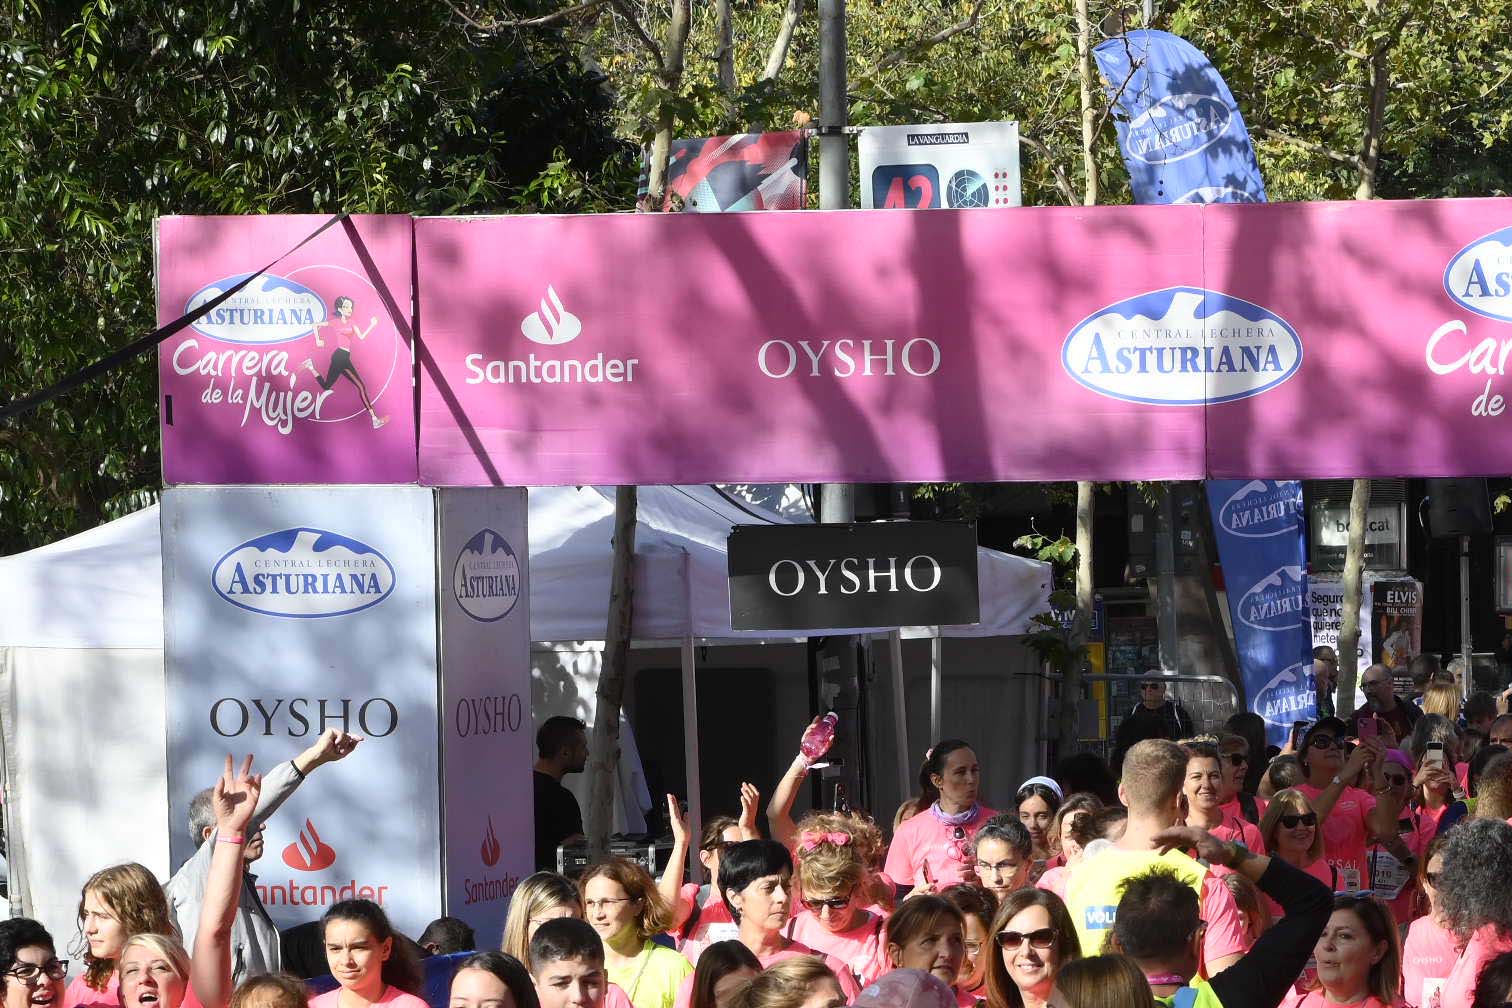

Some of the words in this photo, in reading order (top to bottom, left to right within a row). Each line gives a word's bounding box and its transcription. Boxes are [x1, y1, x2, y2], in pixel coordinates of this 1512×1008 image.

[920, 132, 968, 144] VANGUARDIA
[196, 299, 315, 325] ASTURIANA
[1117, 326, 1192, 339] CENTRAL
[1204, 325, 1276, 338] LECHERA
[172, 339, 289, 377] Carrera
[465, 353, 639, 384] Santander
[758, 337, 941, 379] OYSHO
[1082, 331, 1284, 375] ASTURIANA
[201, 377, 223, 404] de
[228, 384, 244, 404] la
[241, 374, 334, 435] Mujer
[1471, 379, 1505, 417] de
[226, 561, 384, 595] ASTURIANA
[254, 559, 313, 568] CENTRAL
[317, 559, 377, 568] LECHERA
[768, 554, 942, 597] OYSHO
[458, 564, 518, 600] ASTURIANA
[1386, 591, 1417, 603] ELVIS
[1312, 608, 1330, 619] que
[1313, 620, 1345, 633] quiere
[209, 697, 399, 738] OYSHO
[456, 693, 522, 739] OYSHO
